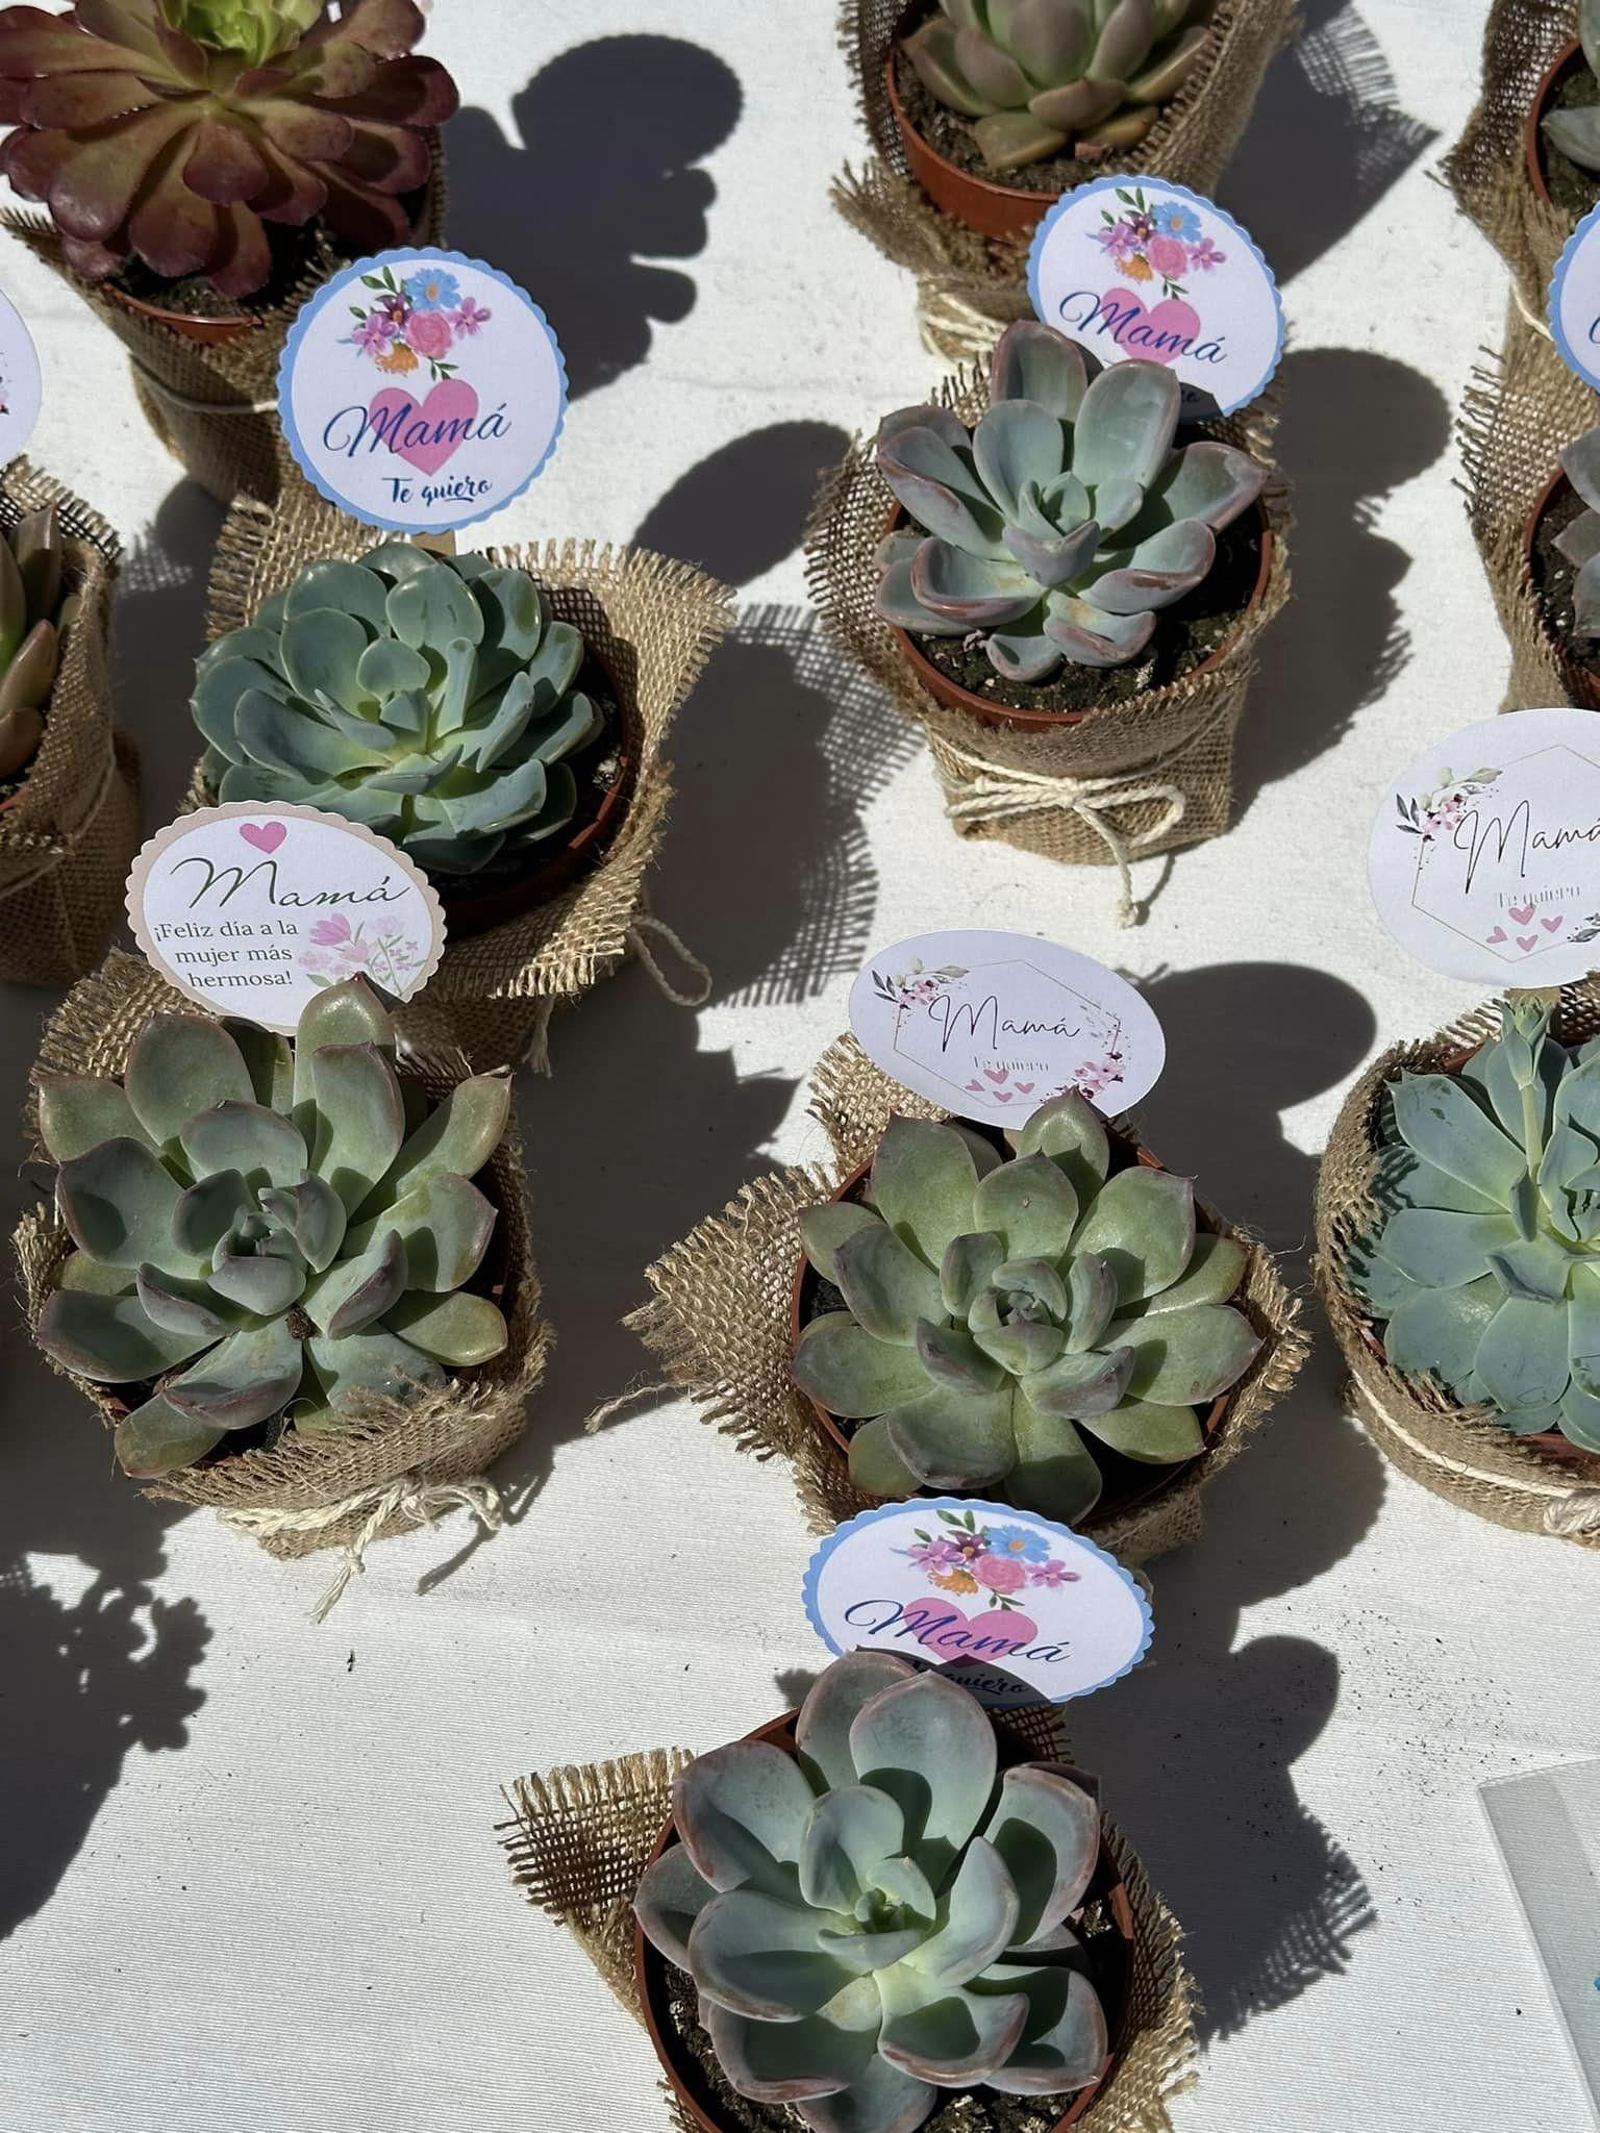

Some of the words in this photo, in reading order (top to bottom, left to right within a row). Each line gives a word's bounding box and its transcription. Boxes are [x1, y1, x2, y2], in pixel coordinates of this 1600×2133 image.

[1059, 291, 1228, 364] Mamá
[323, 402, 512, 458] Mamá
[381, 477, 413, 503] Te
[420, 475, 493, 507] quiero
[169, 857, 411, 909] Mamá
[154, 921, 213, 942] ¡Feliz
[220, 920, 253, 937] día
[260, 923, 273, 936] a
[277, 918, 299, 936] la
[175, 945, 240, 969] mujer
[247, 944, 293, 962] más
[187, 970, 293, 988] hermosa!
[928, 994, 1081, 1052] Mamá
[844, 1598, 1072, 1663] Mamá
